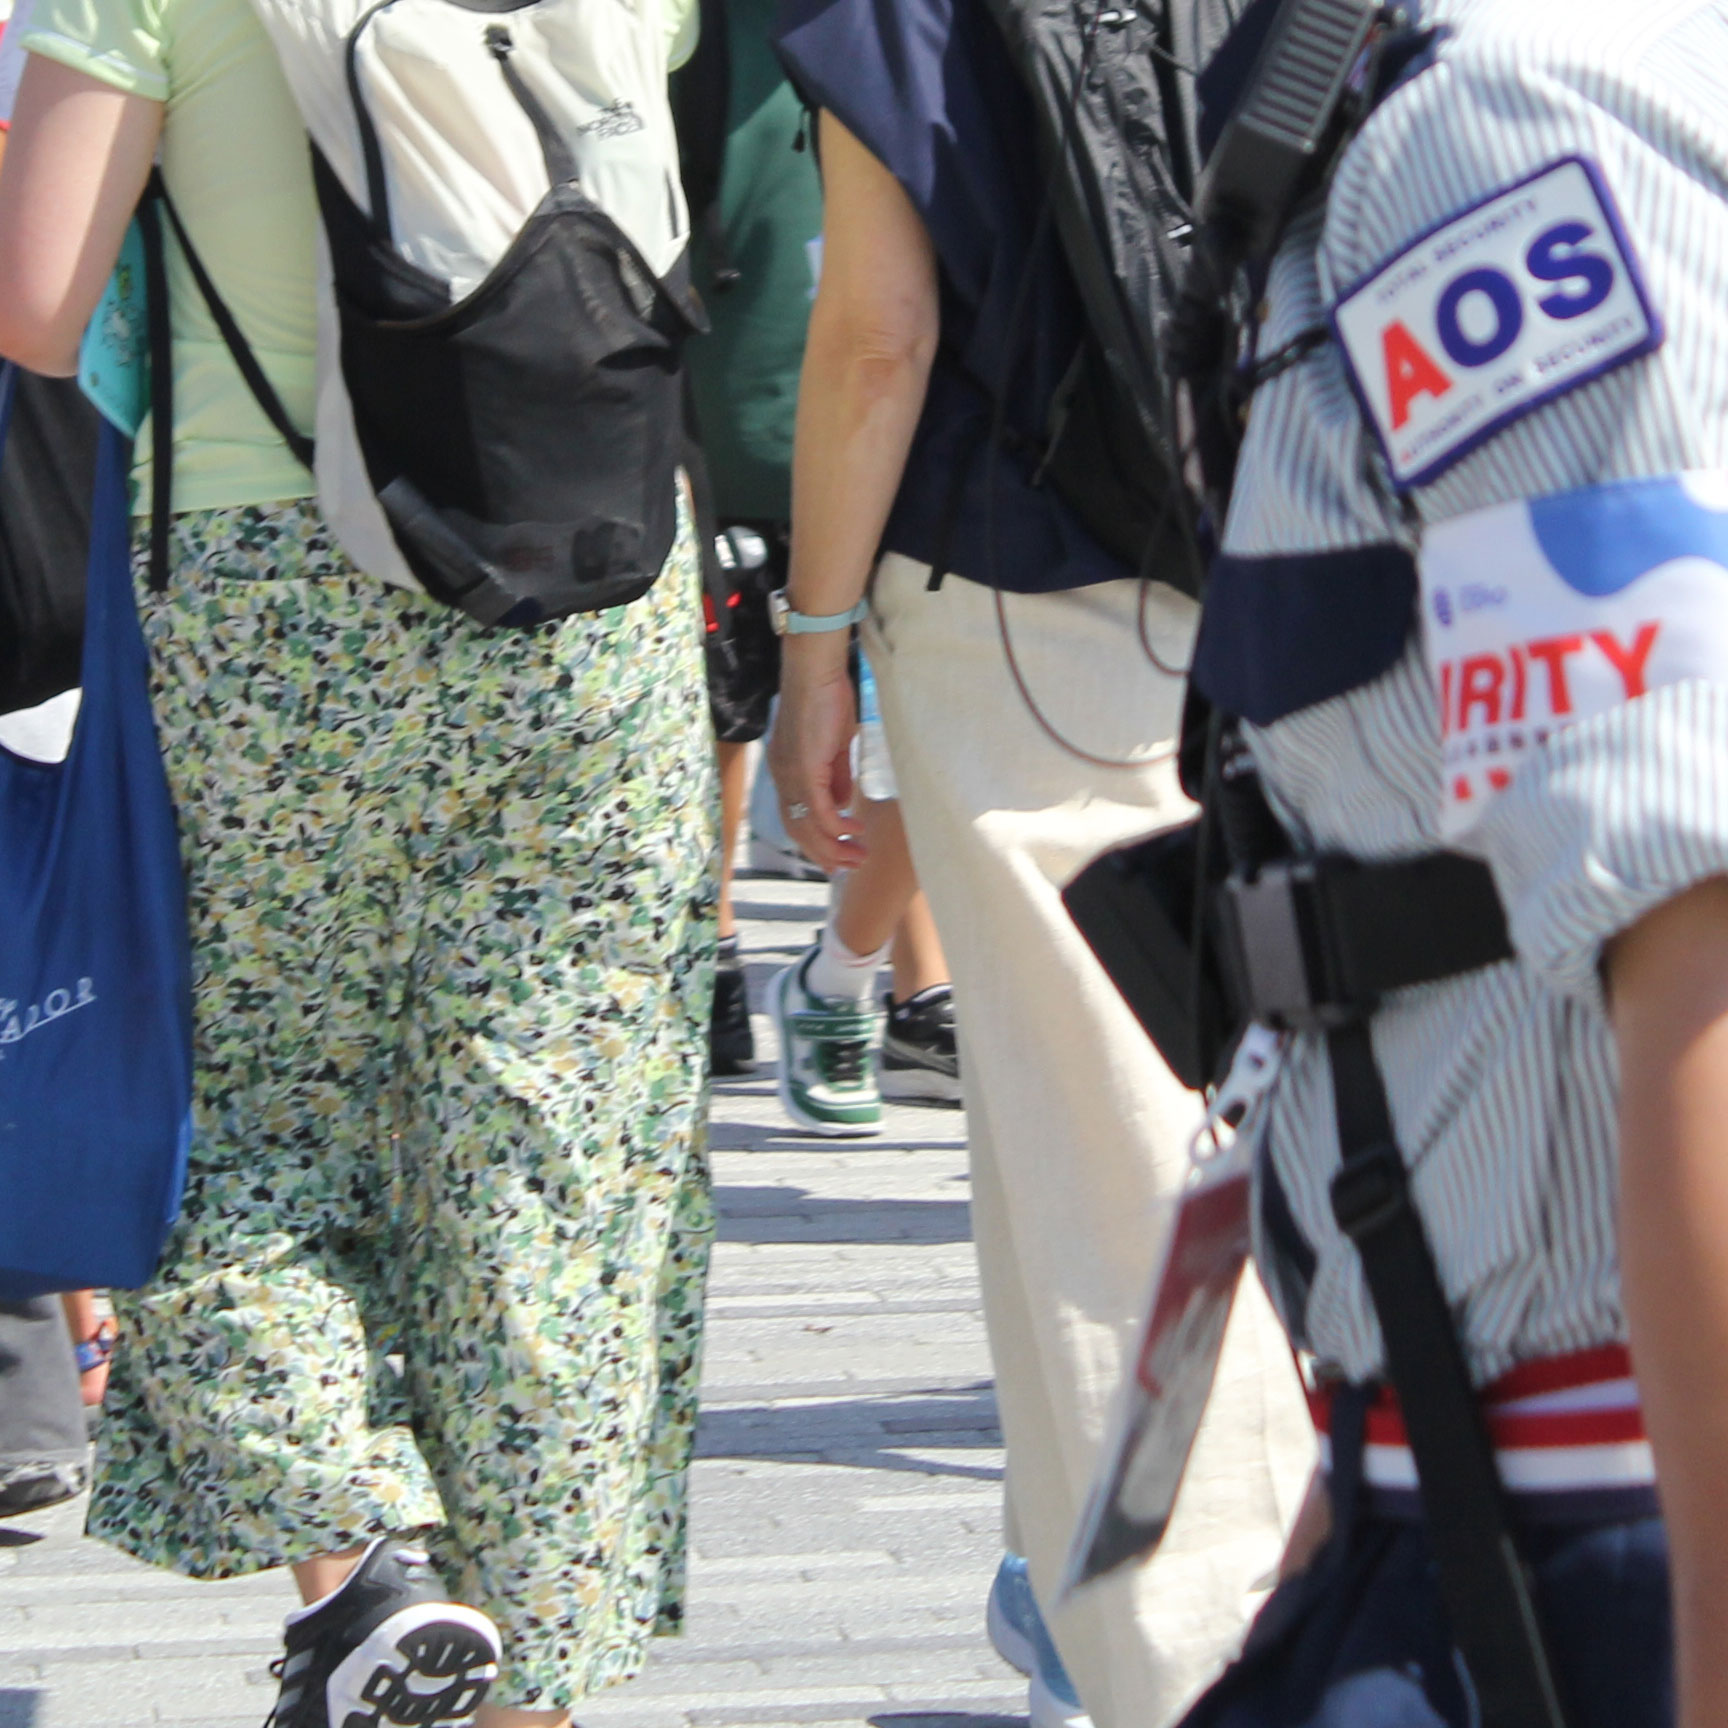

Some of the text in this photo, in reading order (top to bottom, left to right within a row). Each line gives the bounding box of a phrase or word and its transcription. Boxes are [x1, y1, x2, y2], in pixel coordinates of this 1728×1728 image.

[1433, 198, 1537, 261] SECURITY
[1381, 218, 1615, 432] AOS
[1534, 316, 1636, 373] SECURITY
